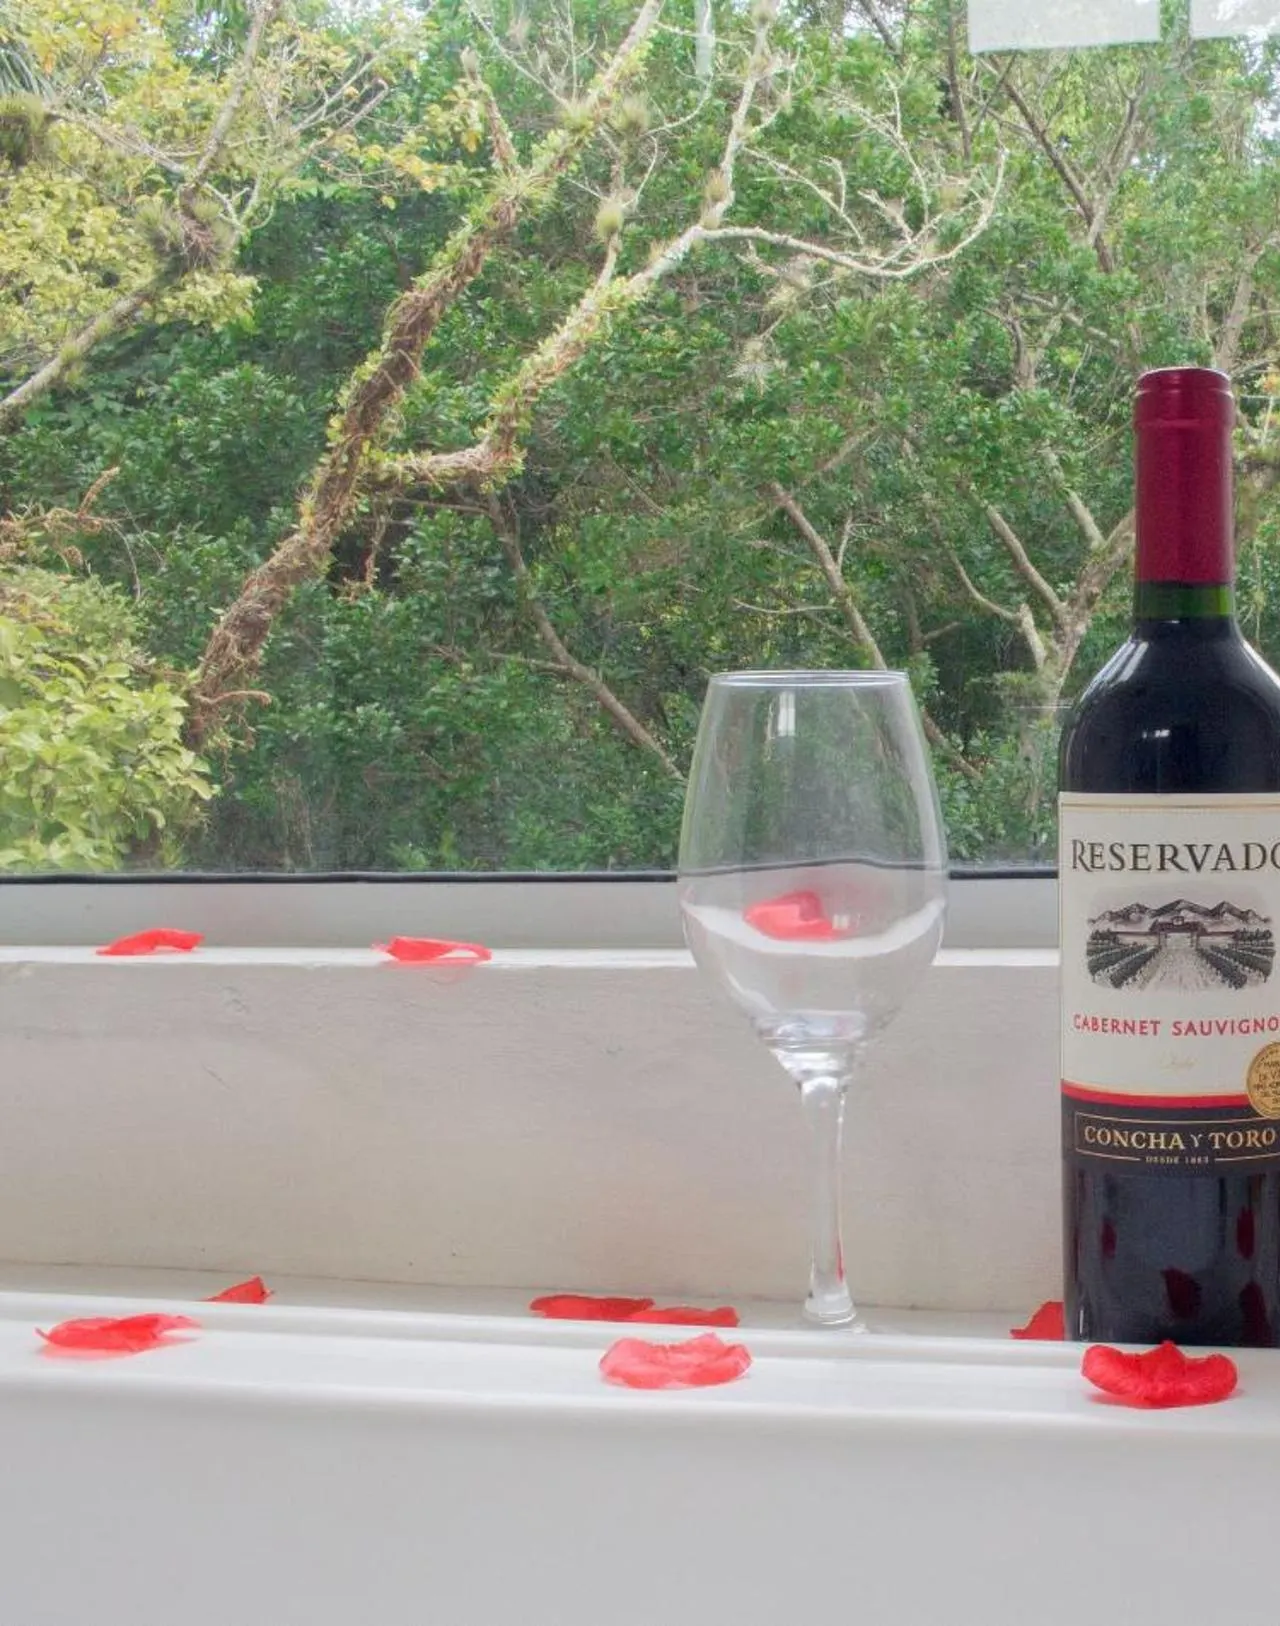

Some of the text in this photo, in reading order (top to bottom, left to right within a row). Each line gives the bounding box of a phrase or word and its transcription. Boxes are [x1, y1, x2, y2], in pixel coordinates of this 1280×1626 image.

[1073, 1014, 1160, 1036] CABERNET
[1084, 1125, 1277, 1150] CONCHA Y TORO
